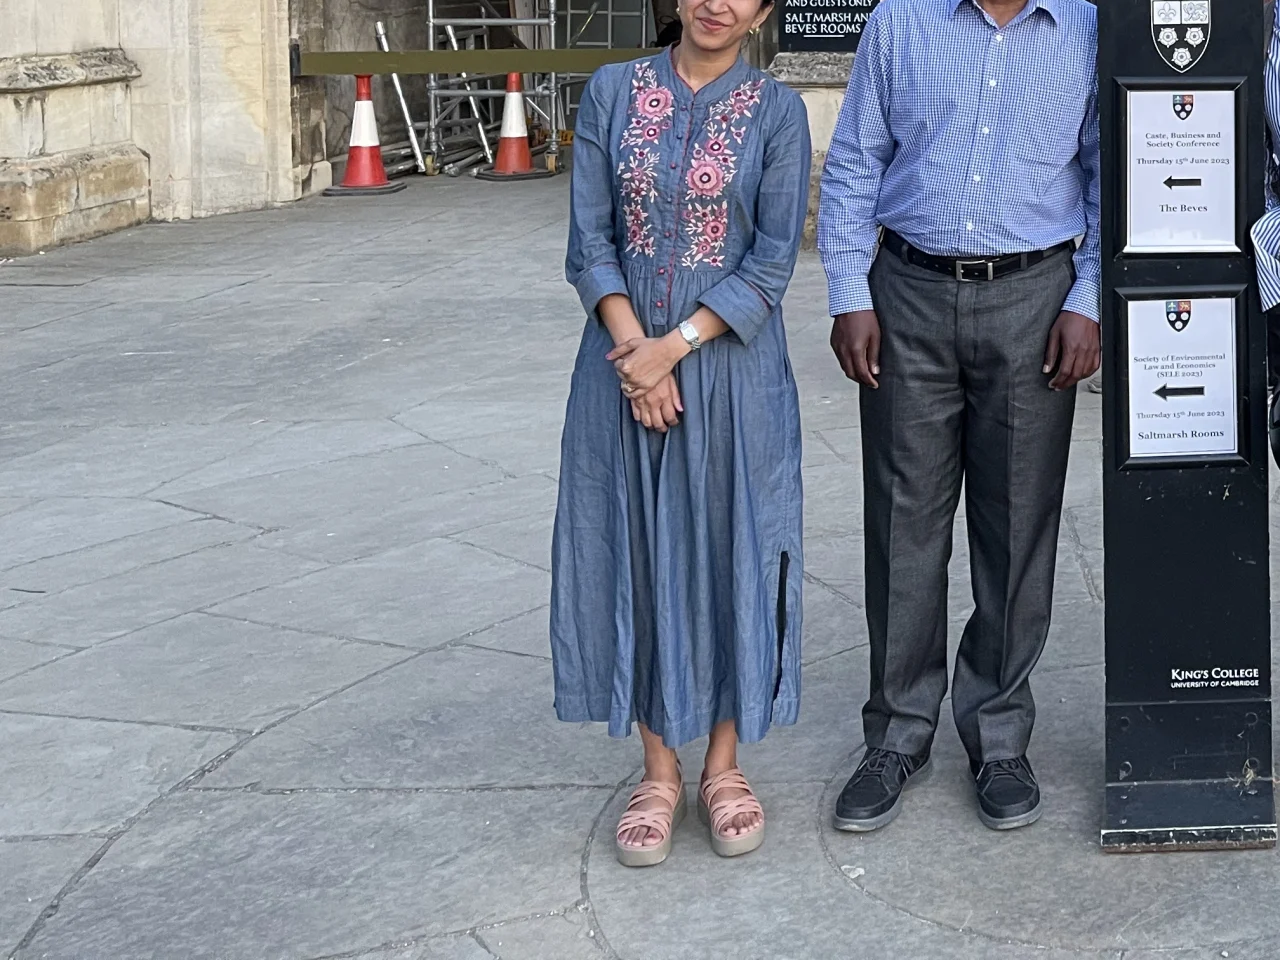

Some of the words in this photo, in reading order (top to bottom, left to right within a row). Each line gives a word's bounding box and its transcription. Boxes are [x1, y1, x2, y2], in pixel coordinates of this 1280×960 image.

[785, 13, 851, 23] SALTMARSH
[853, 13, 872, 22] AN
[785, 24, 817, 34] BEVES
[820, 23, 861, 34] ROOMS
[1145, 132, 1169, 140] Caste,
[1136, 157, 1173, 165] Thursday
[1159, 204, 1178, 213] The
[1180, 204, 1208, 213] Beves
[1170, 353, 1226, 361] Environmental
[1136, 412, 1171, 420] Thursday
[1138, 430, 1188, 440] Saltmarsh
[1190, 430, 1225, 438] Rooms
[1170, 681, 1209, 689] UNIVERSITY
